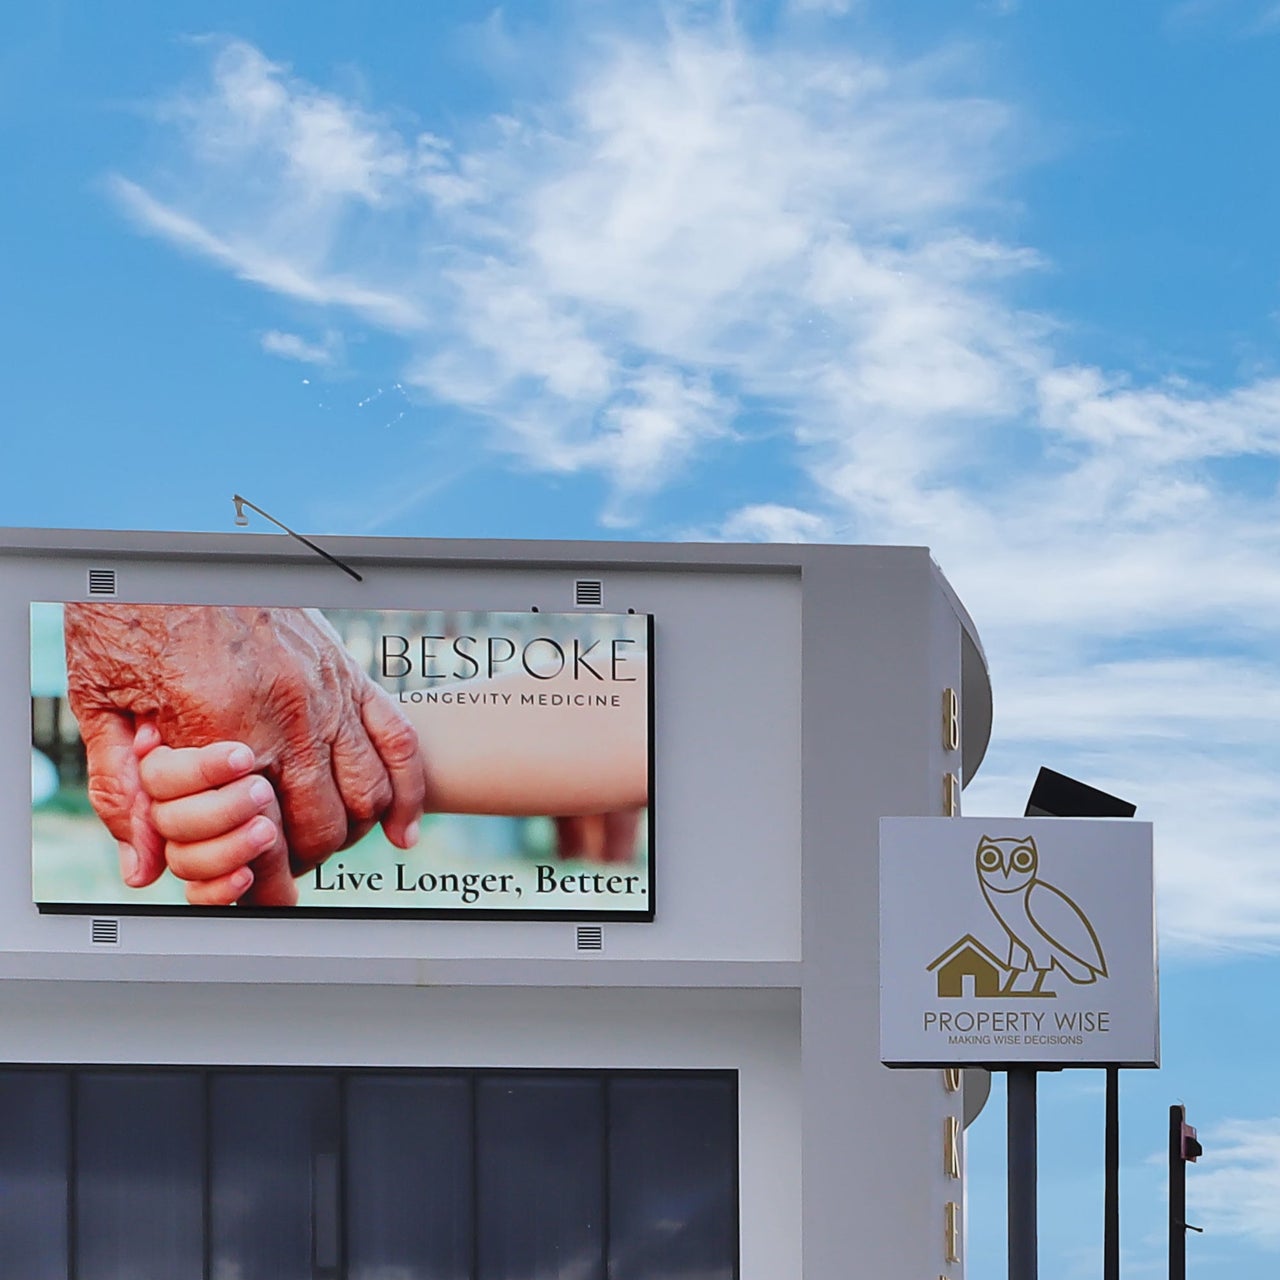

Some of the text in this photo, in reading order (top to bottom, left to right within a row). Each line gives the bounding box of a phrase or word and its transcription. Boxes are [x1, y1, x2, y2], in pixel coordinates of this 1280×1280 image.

[382, 635, 637, 682] BESPOKE
[399, 691, 621, 706] LONGEVITY MEDICINE
[314, 862, 647, 904] Live Longer, Better.
[923, 1011, 1111, 1033] PROPERTY WISE
[948, 1035, 1083, 1046] MAKING WISE DECISIONS
